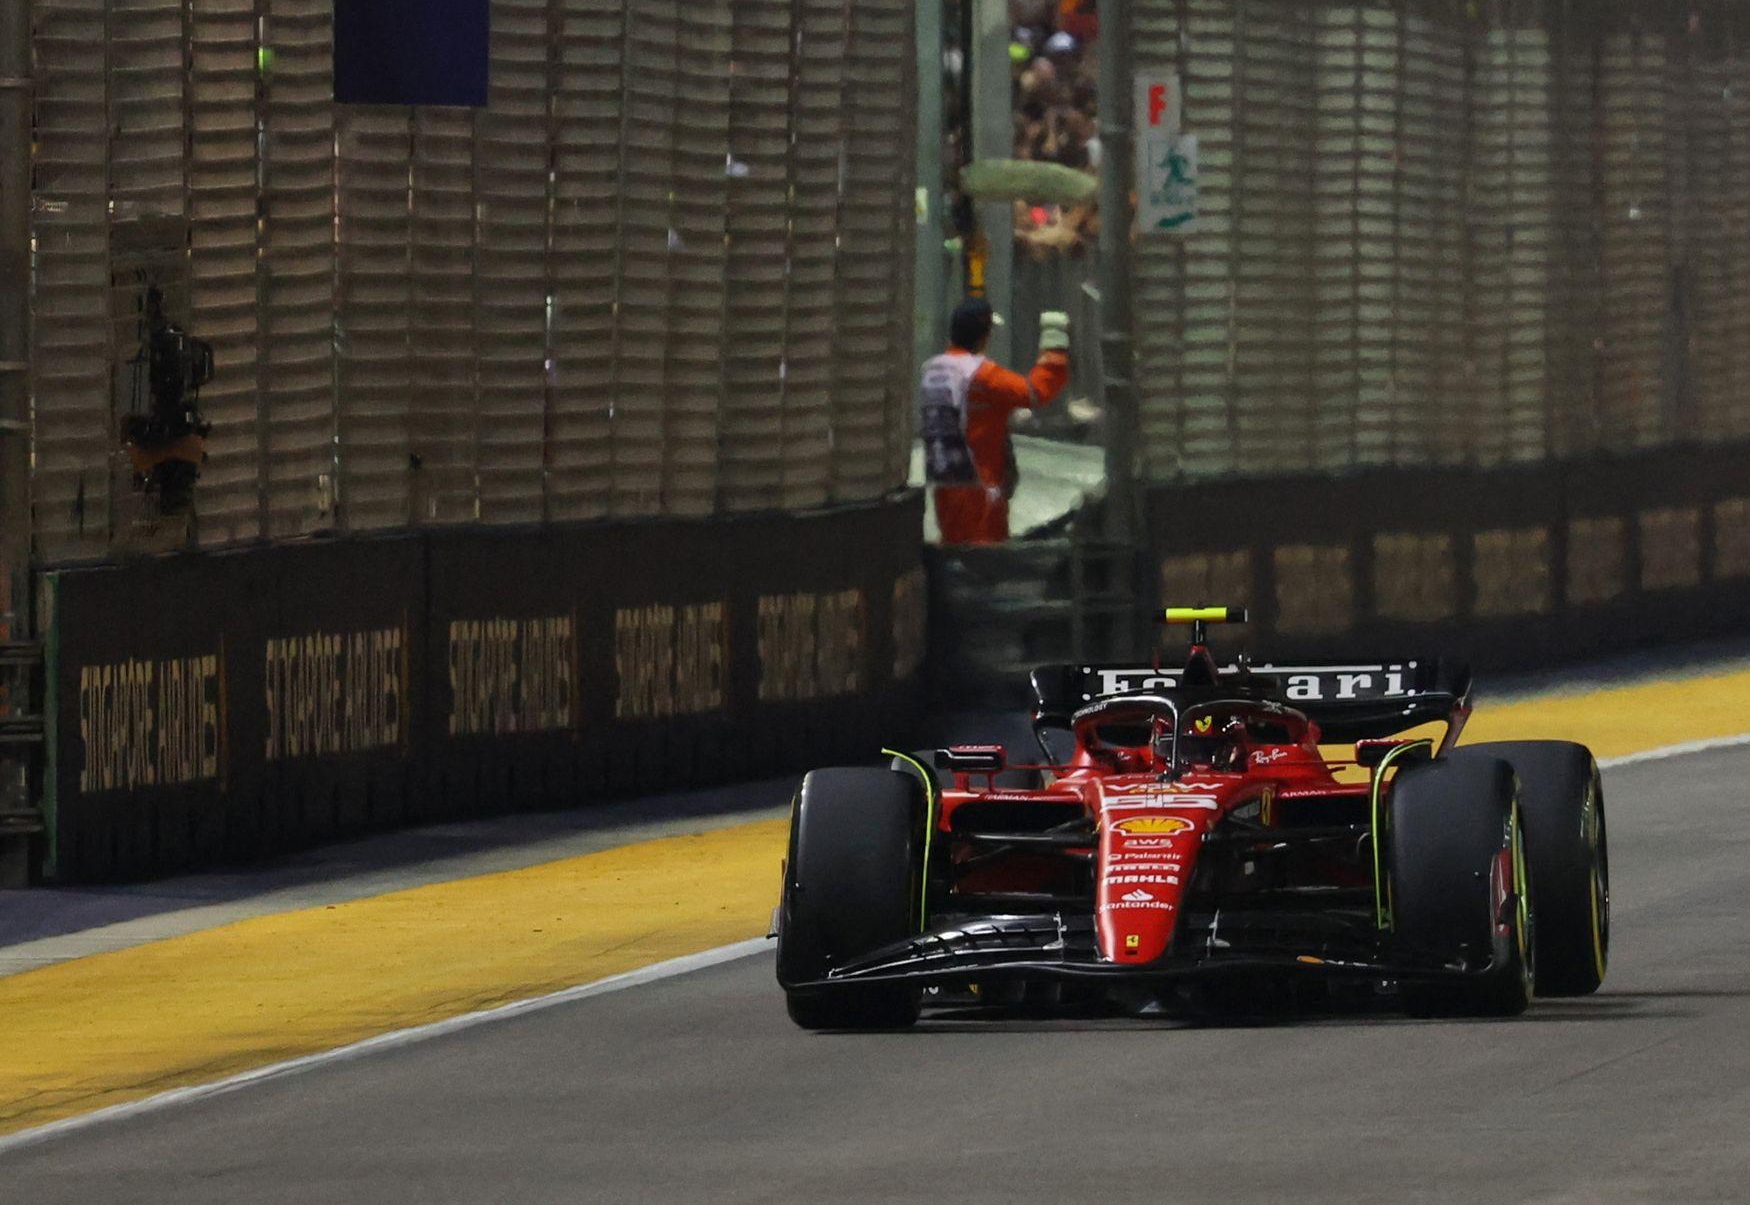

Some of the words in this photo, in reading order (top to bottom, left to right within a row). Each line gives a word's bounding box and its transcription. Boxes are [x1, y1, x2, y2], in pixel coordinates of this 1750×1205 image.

[1148, 83, 1167, 126] F
[80, 656, 154, 791] SINGAPORE
[158, 654, 217, 786] AIRLINES
[1103, 874, 1179, 886] MAHLE
